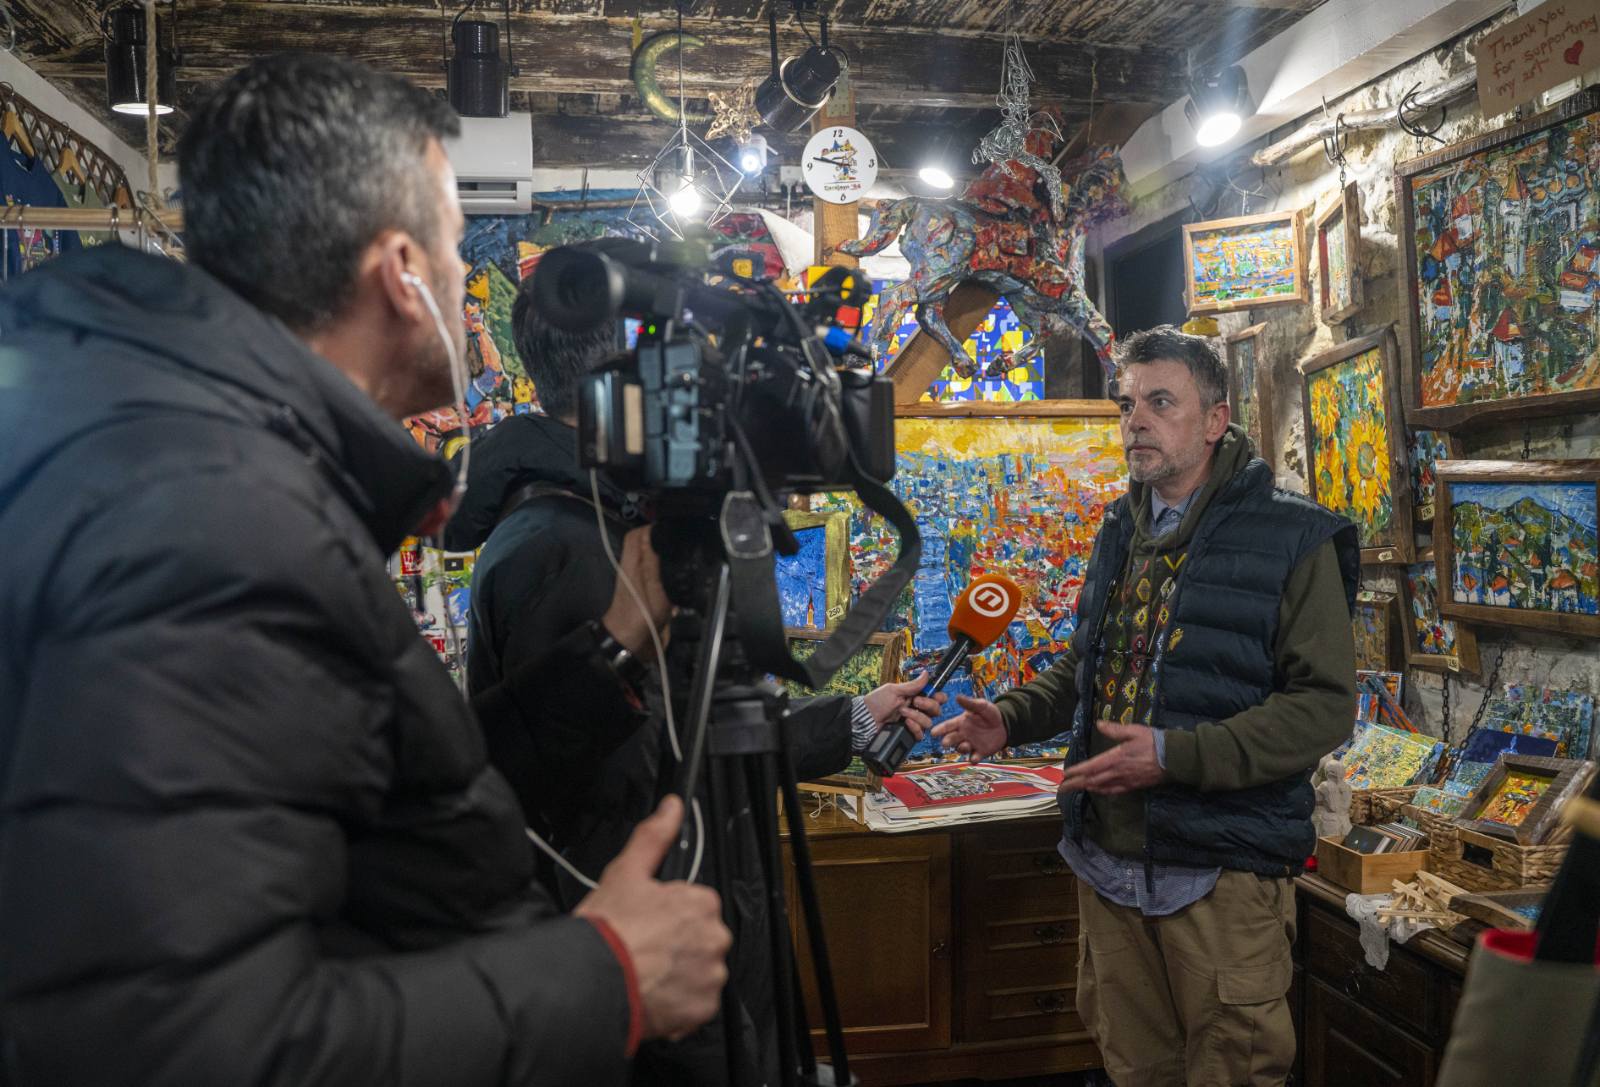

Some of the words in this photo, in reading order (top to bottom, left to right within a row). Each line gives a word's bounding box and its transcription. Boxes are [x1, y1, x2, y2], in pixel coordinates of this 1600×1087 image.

[1488, 24, 1536, 58] Thank
[1493, 59, 1516, 78] for
[1496, 78, 1516, 99] my
[832, 129, 843, 137] 12
[807, 162, 813, 170] 9
[868, 159, 875, 167] 3
[840, 193, 846, 201] 6
